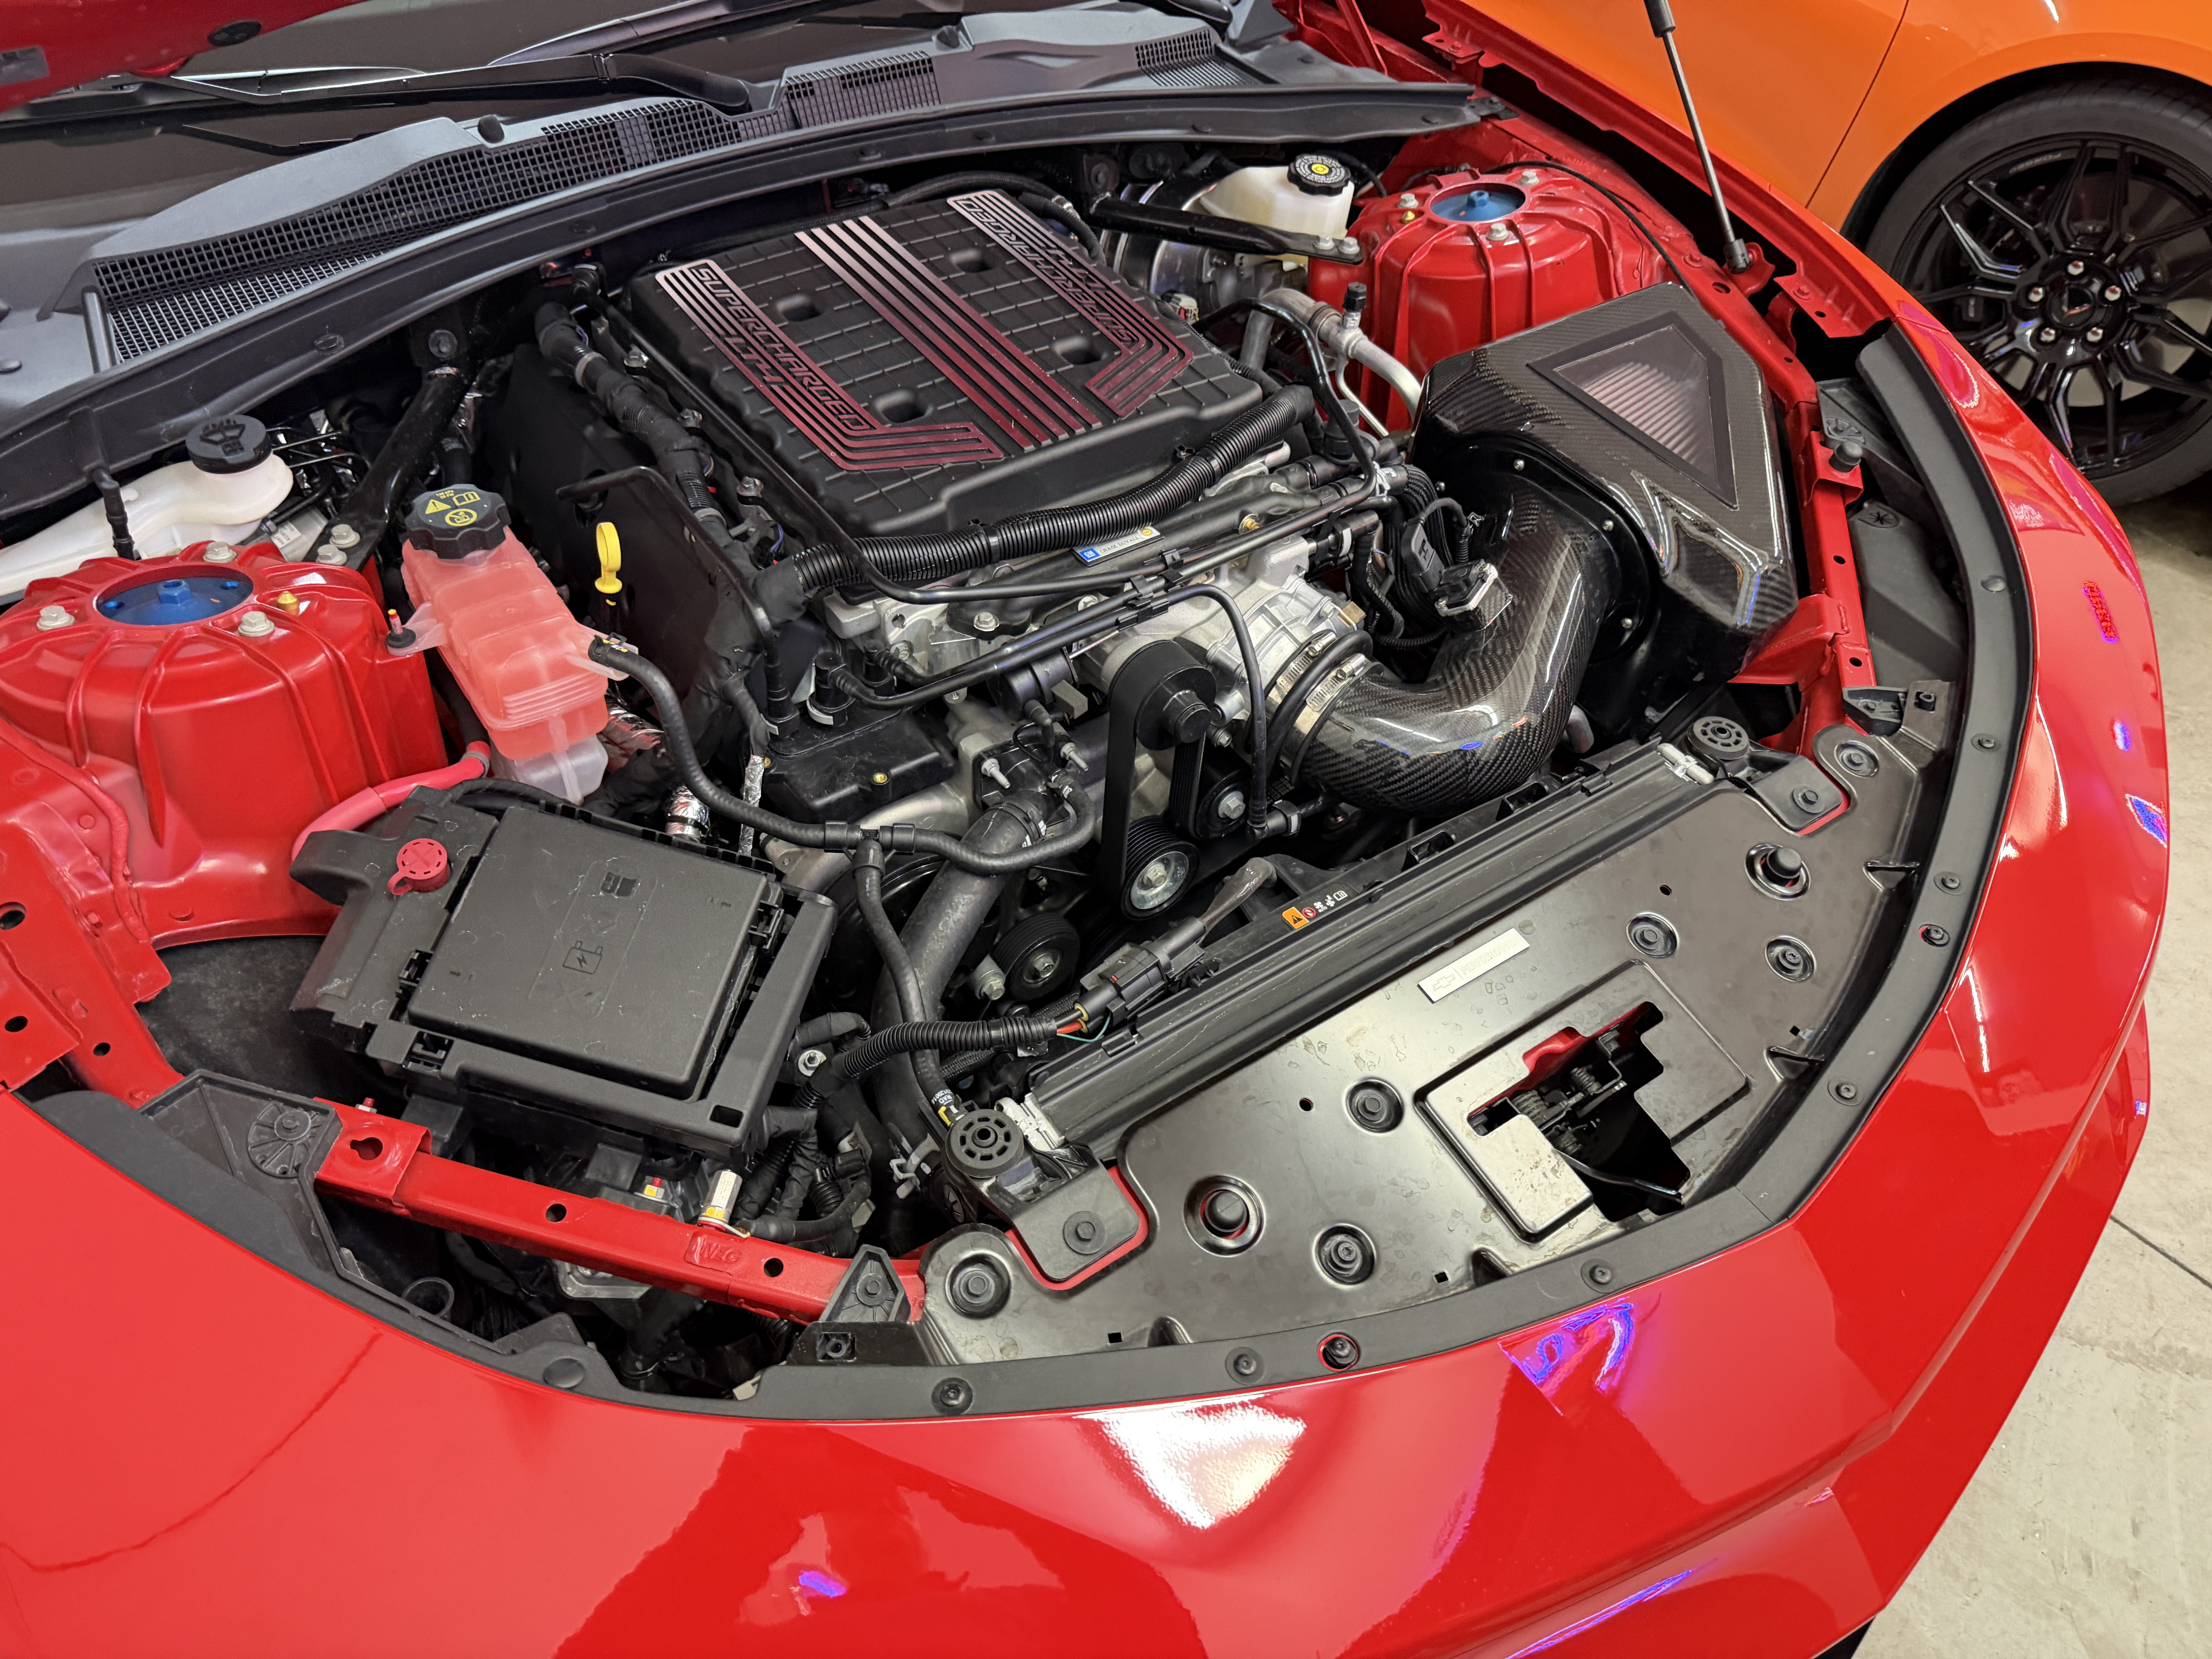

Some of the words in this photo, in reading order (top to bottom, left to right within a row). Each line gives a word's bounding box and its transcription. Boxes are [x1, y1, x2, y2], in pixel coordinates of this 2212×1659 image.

[958, 200, 1133, 341] SUPERCHARGED
[1046, 249, 1106, 289] LT4
[692, 268, 871, 430] SUPERCHARGED
[725, 337, 785, 383] LT4
[1100, 545, 1118, 553] CHASE
[1117, 536, 1140, 546] DUVALL
[1460, 936, 1520, 975] PERFORMANCE
[939, 1094, 953, 1104] RAD
